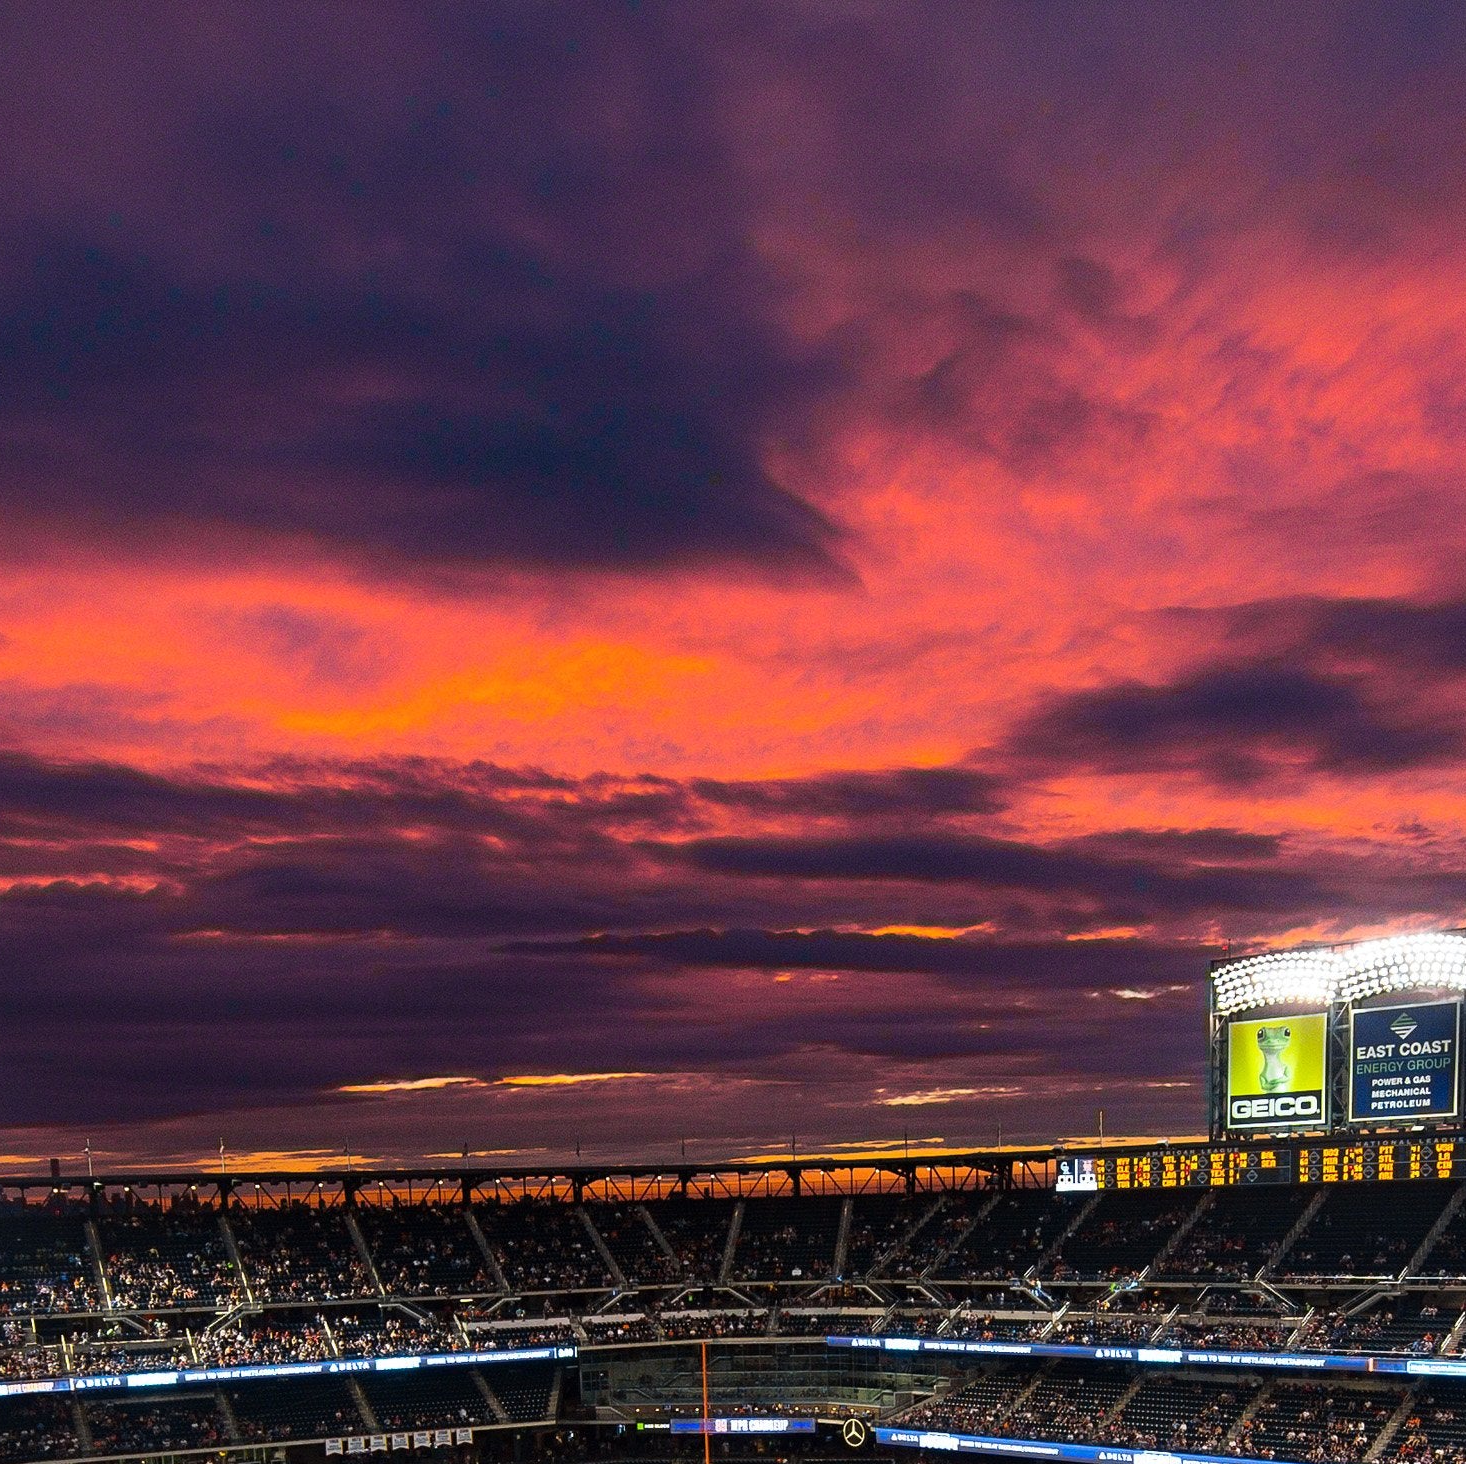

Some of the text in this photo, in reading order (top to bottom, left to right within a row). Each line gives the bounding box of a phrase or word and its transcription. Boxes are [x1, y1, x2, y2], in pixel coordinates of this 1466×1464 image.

[1356, 1039, 1452, 1060] EAST COAST
[1355, 1057, 1451, 1075] ENERGY GROUP
[1371, 1075, 1431, 1087] POWER & GAS
[1371, 1087, 1431, 1098] MECHANICAL
[1231, 1095, 1318, 1119] GEICO
[1371, 1098, 1430, 1110] PETROLEUM
[1355, 1136, 1464, 1148] NATIONAL LEAGUE
[1146, 1149, 1195, 1157] AMERICAN
[1378, 1154, 1394, 1163] STL
